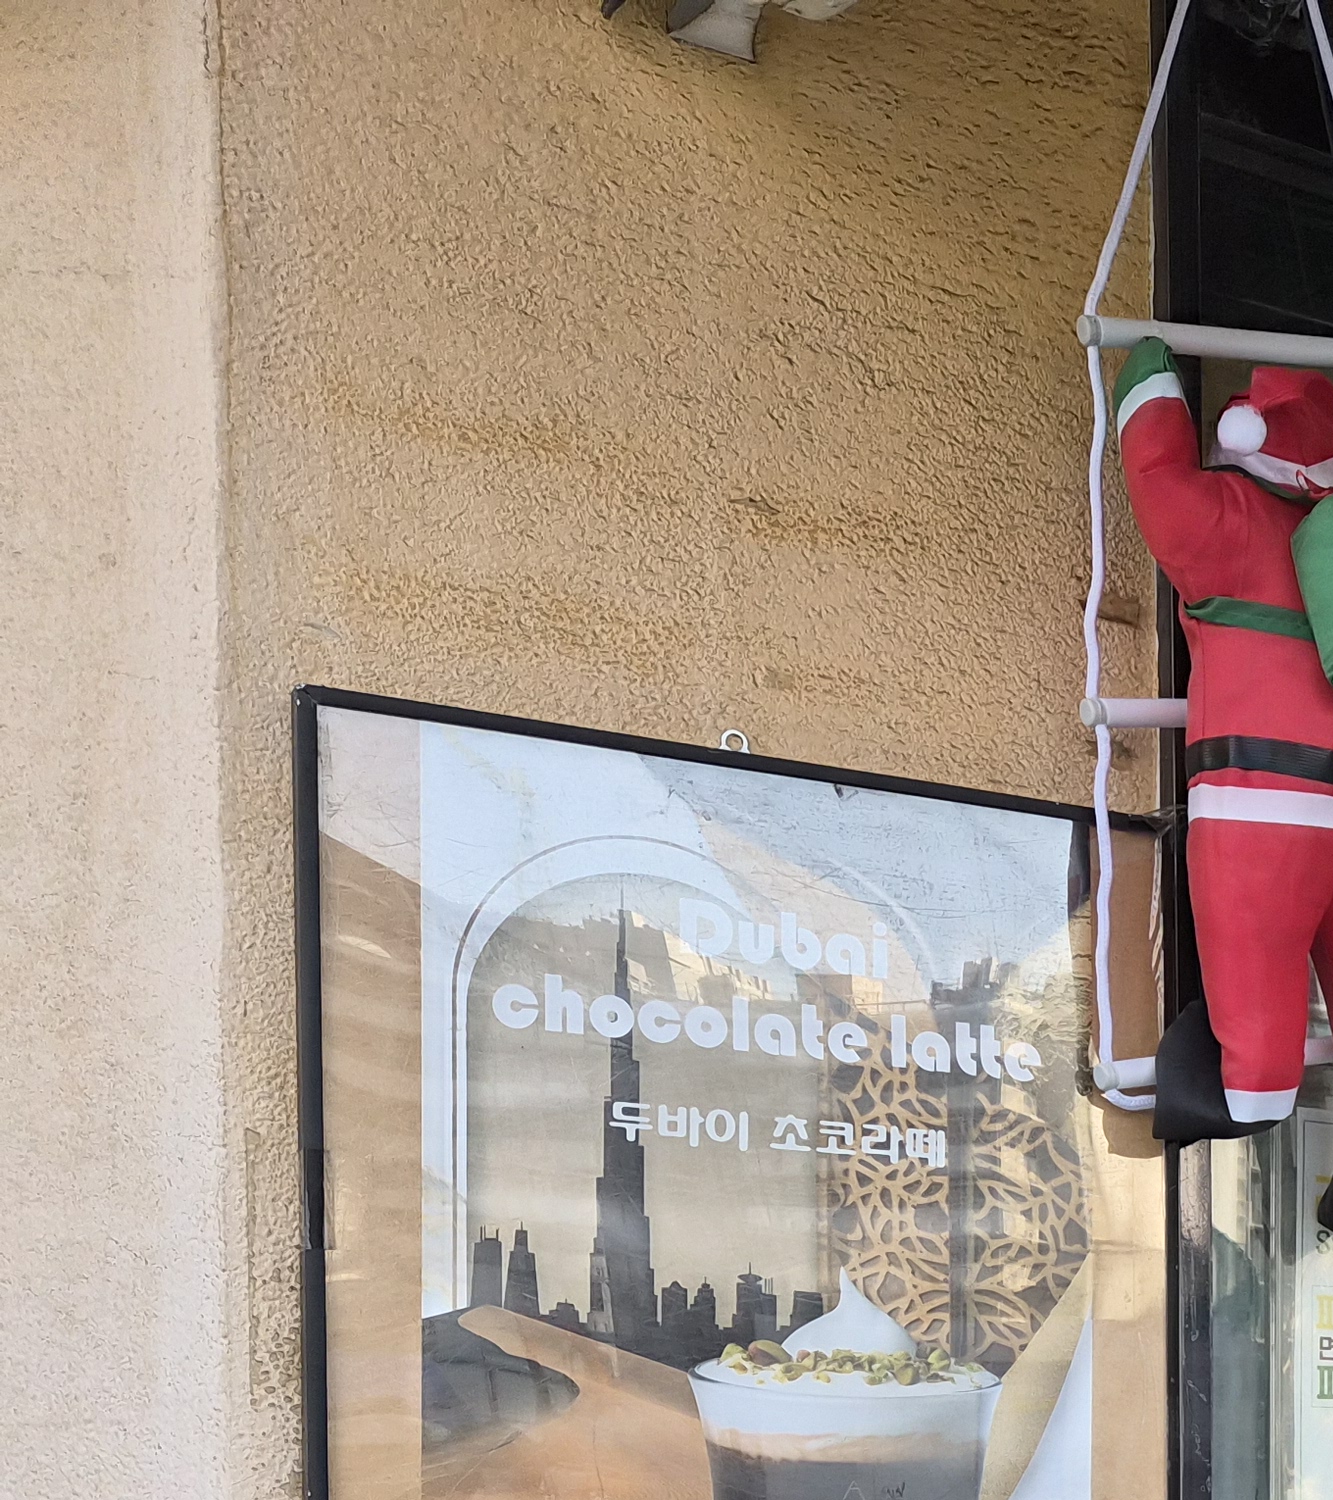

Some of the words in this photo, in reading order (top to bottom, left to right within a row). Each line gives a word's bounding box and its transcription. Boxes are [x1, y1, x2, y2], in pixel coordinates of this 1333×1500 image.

[676, 896, 891, 981] Dubai
[491, 982, 866, 1068] chocolate
[890, 1010, 1044, 1084] latte
[607, 1099, 751, 1156] 두바이
[769, 1113, 950, 1170] 초코라떼
